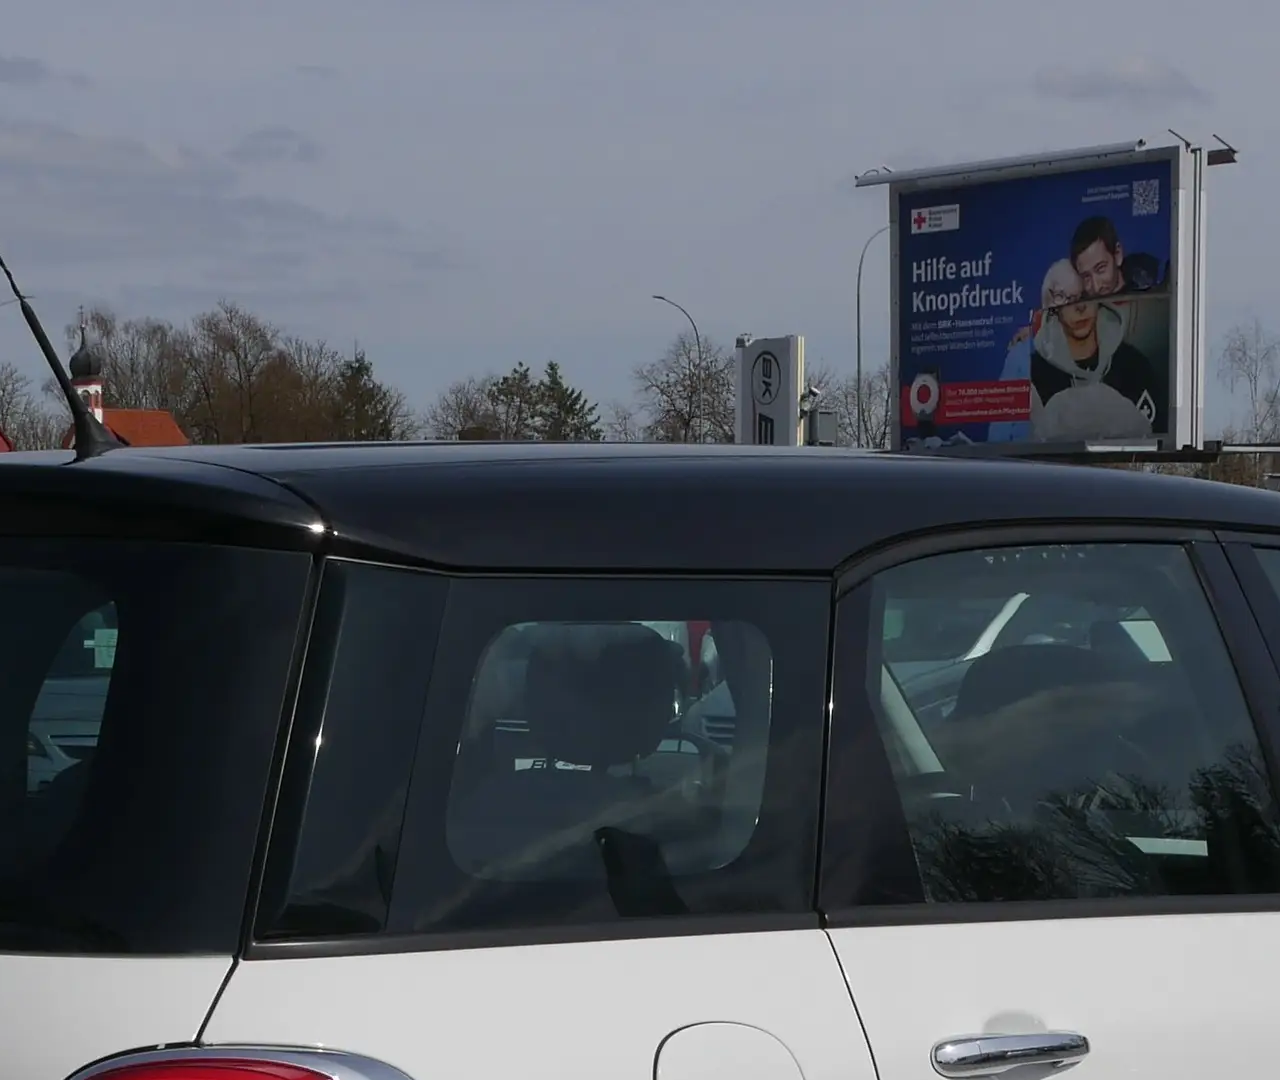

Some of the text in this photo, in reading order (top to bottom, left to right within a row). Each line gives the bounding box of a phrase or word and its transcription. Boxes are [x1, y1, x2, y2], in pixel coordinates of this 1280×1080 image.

[913, 251, 992, 283] Hilfe auf
[913, 280, 1024, 316] Knopfdruck
